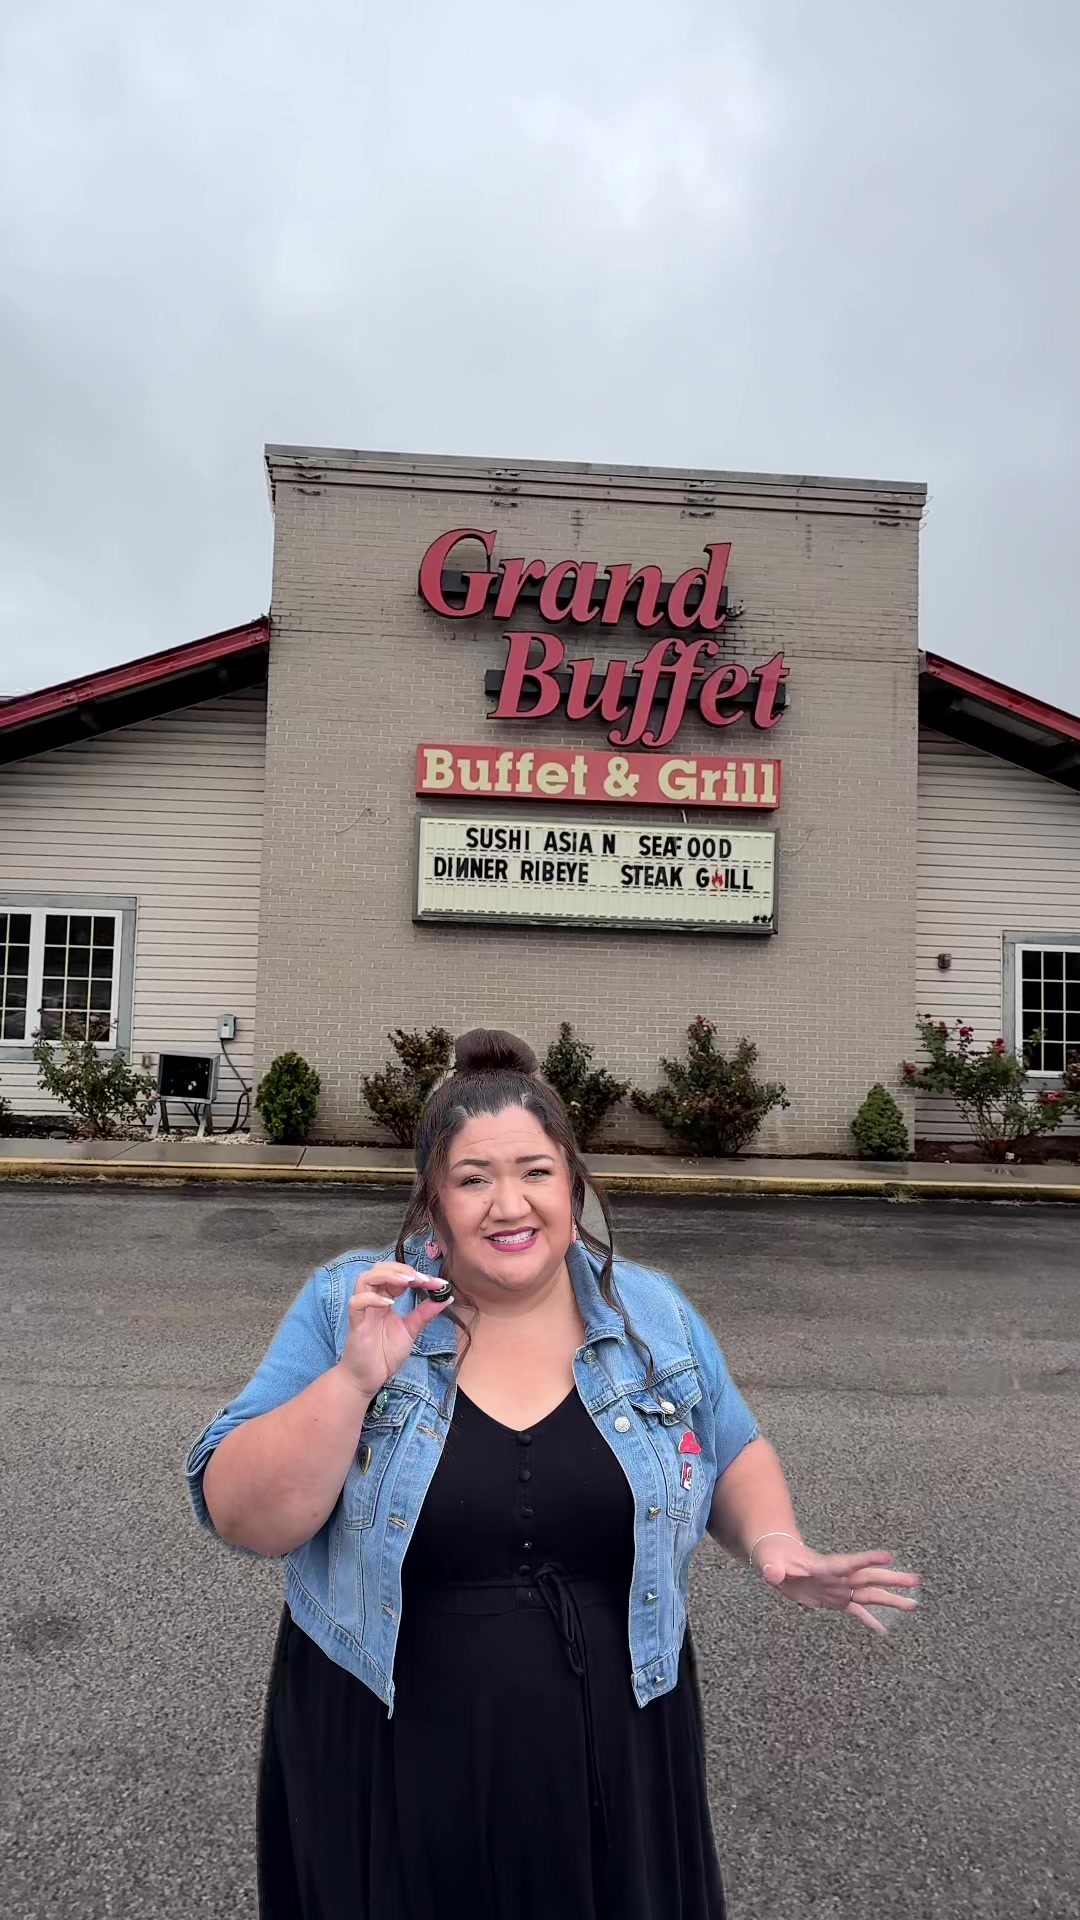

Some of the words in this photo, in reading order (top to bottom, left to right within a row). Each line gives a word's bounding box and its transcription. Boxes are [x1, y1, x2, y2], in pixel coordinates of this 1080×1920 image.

[420, 528, 732, 630] Grand
[486, 631, 791, 748] Buffet
[422, 748, 588, 796] Buffet
[603, 756, 640, 798] &
[658, 759, 777, 804] Grill
[466, 827, 530, 850] SUSHI
[639, 834, 732, 858] SEAFOOD
[434, 856, 508, 880] DINNER
[520, 860, 589, 883] RIBEYE
[621, 864, 683, 887] STEAK
[696, 867, 754, 890] GILL
